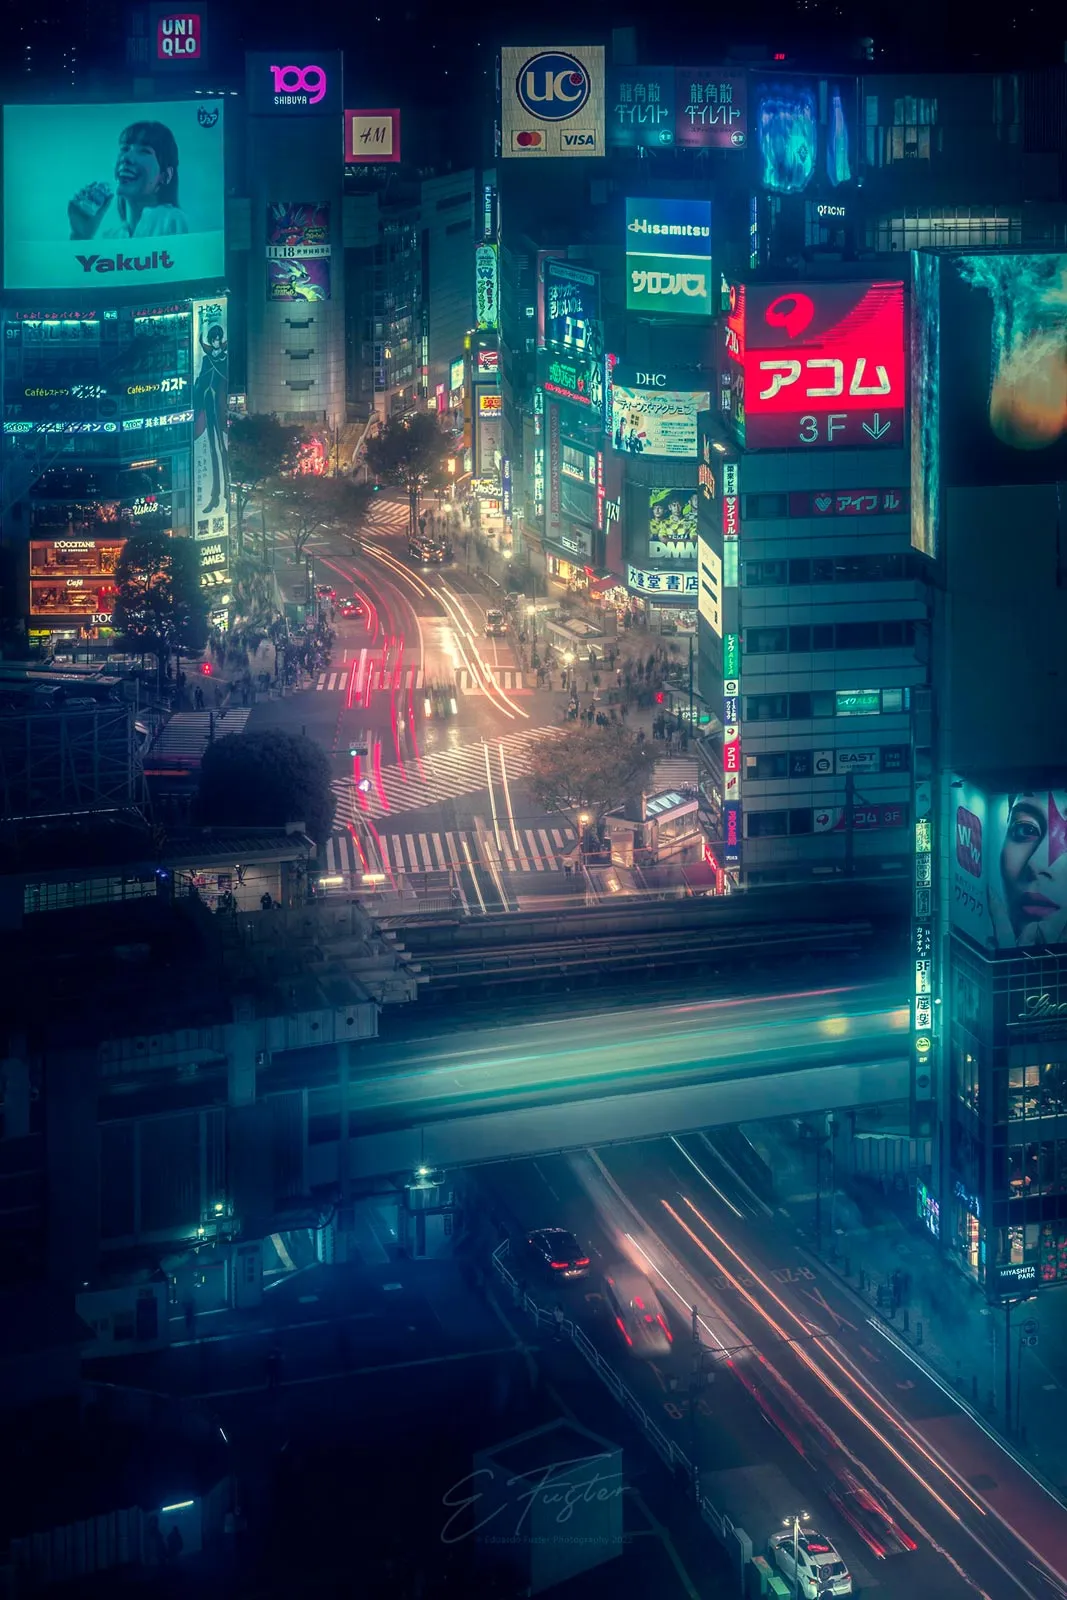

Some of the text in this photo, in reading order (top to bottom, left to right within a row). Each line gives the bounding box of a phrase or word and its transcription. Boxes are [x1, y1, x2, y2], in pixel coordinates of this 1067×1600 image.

[162, 19, 193, 35] UNI
[162, 38, 196, 57] QLO
[270, 65, 327, 104] 109
[620, 82, 660, 102] 龍角散
[690, 82, 733, 103] 龍角散
[274, 96, 307, 105] SHIBUYA
[614, 104, 668, 123] ダイレクト
[684, 105, 741, 125] ダイレクト
[564, 135, 594, 145] VISA
[817, 205, 845, 217] QFRONT
[627, 218, 710, 238] Hisamitsu
[75, 250, 175, 273] Yakult
[268, 247, 295, 257] 11.18
[631, 271, 706, 297] サロンパス
[160, 377, 187, 392] ガスト
[636, 372, 666, 386] DHC
[760, 357, 891, 400] アコム
[799, 414, 848, 443] 3F
[837, 494, 900, 511] アイフル
[727, 505, 736, 534] アイフル
[630, 570, 697, 590] 大盛堂書店
[727, 747, 736, 769] アコム
[839, 752, 876, 762] EAST
[916, 961, 930, 972] 3F
[1000, 1266, 1035, 1277] MIYASHITA
[1017, 1272, 1035, 1280] PARK
